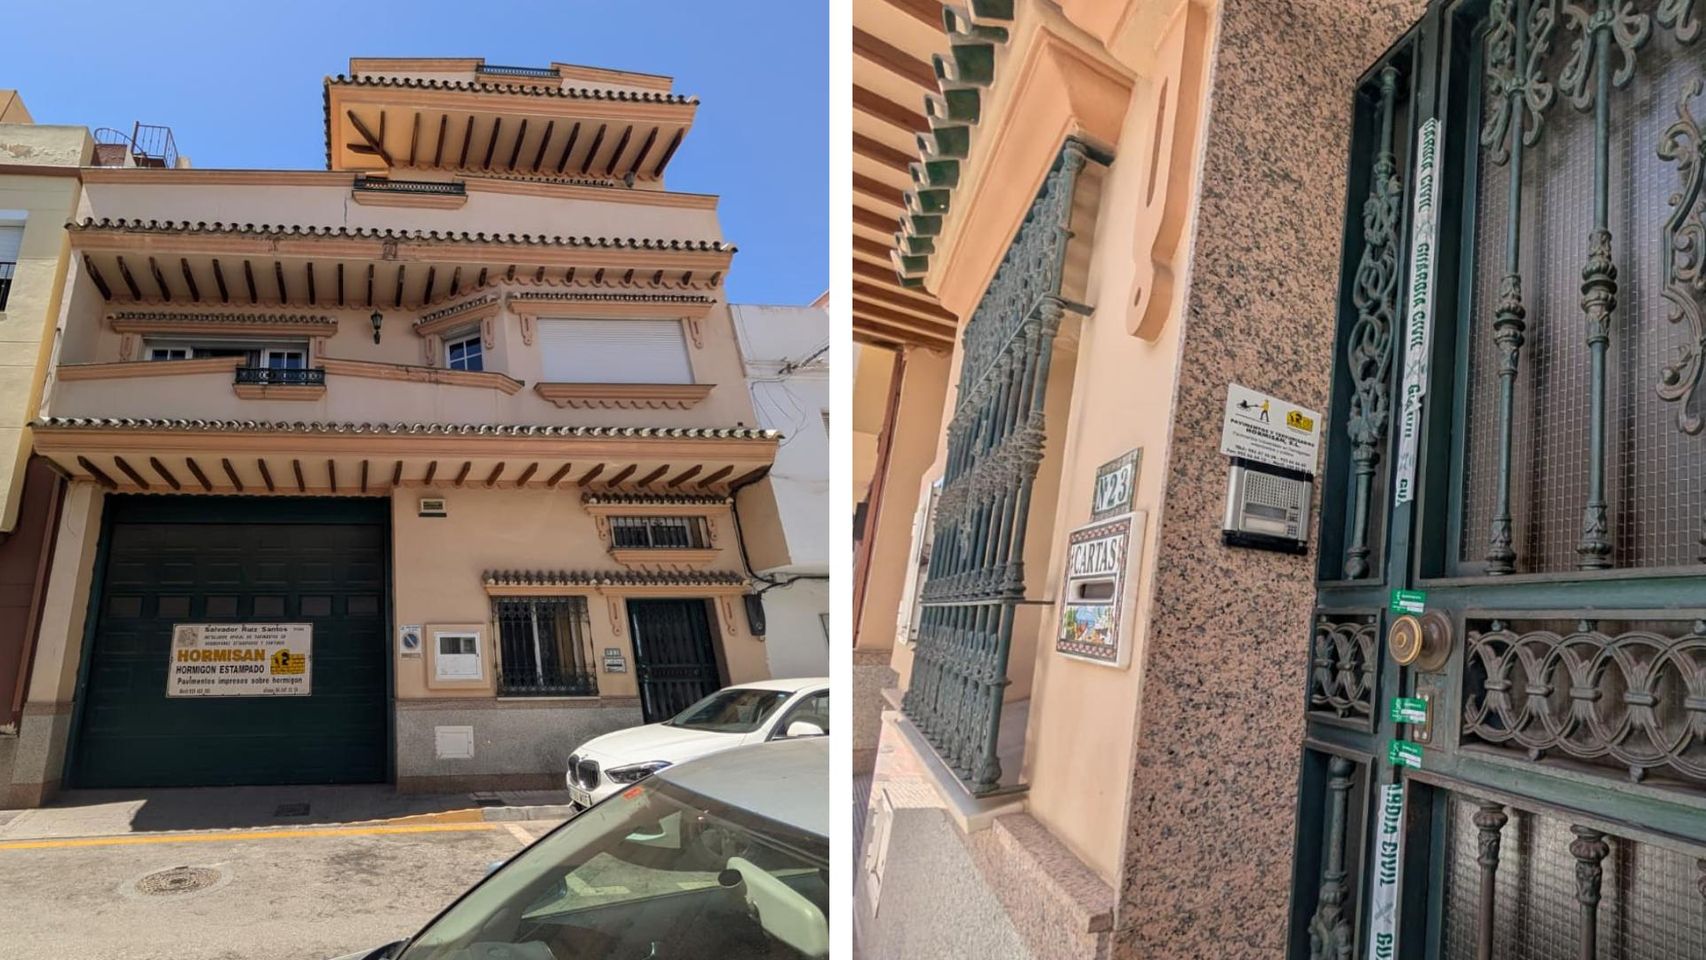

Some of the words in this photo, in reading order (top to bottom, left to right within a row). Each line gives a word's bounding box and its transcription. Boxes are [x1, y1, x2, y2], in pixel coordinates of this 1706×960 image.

[1418, 174, 1433, 214] CIVIL
[1413, 242, 1430, 308] GUARDIA
[1410, 310, 1426, 350] CIVIL
[1107, 468, 1129, 506] 23
[1073, 538, 1117, 574] CARTAS
[177, 649, 266, 662] HORMISAN
[219, 664, 265, 674] ESTAMPADO
[177, 677, 216, 685] Pavimentos
[218, 677, 248, 685] impresos
[1379, 842, 1398, 887] CIVIL
